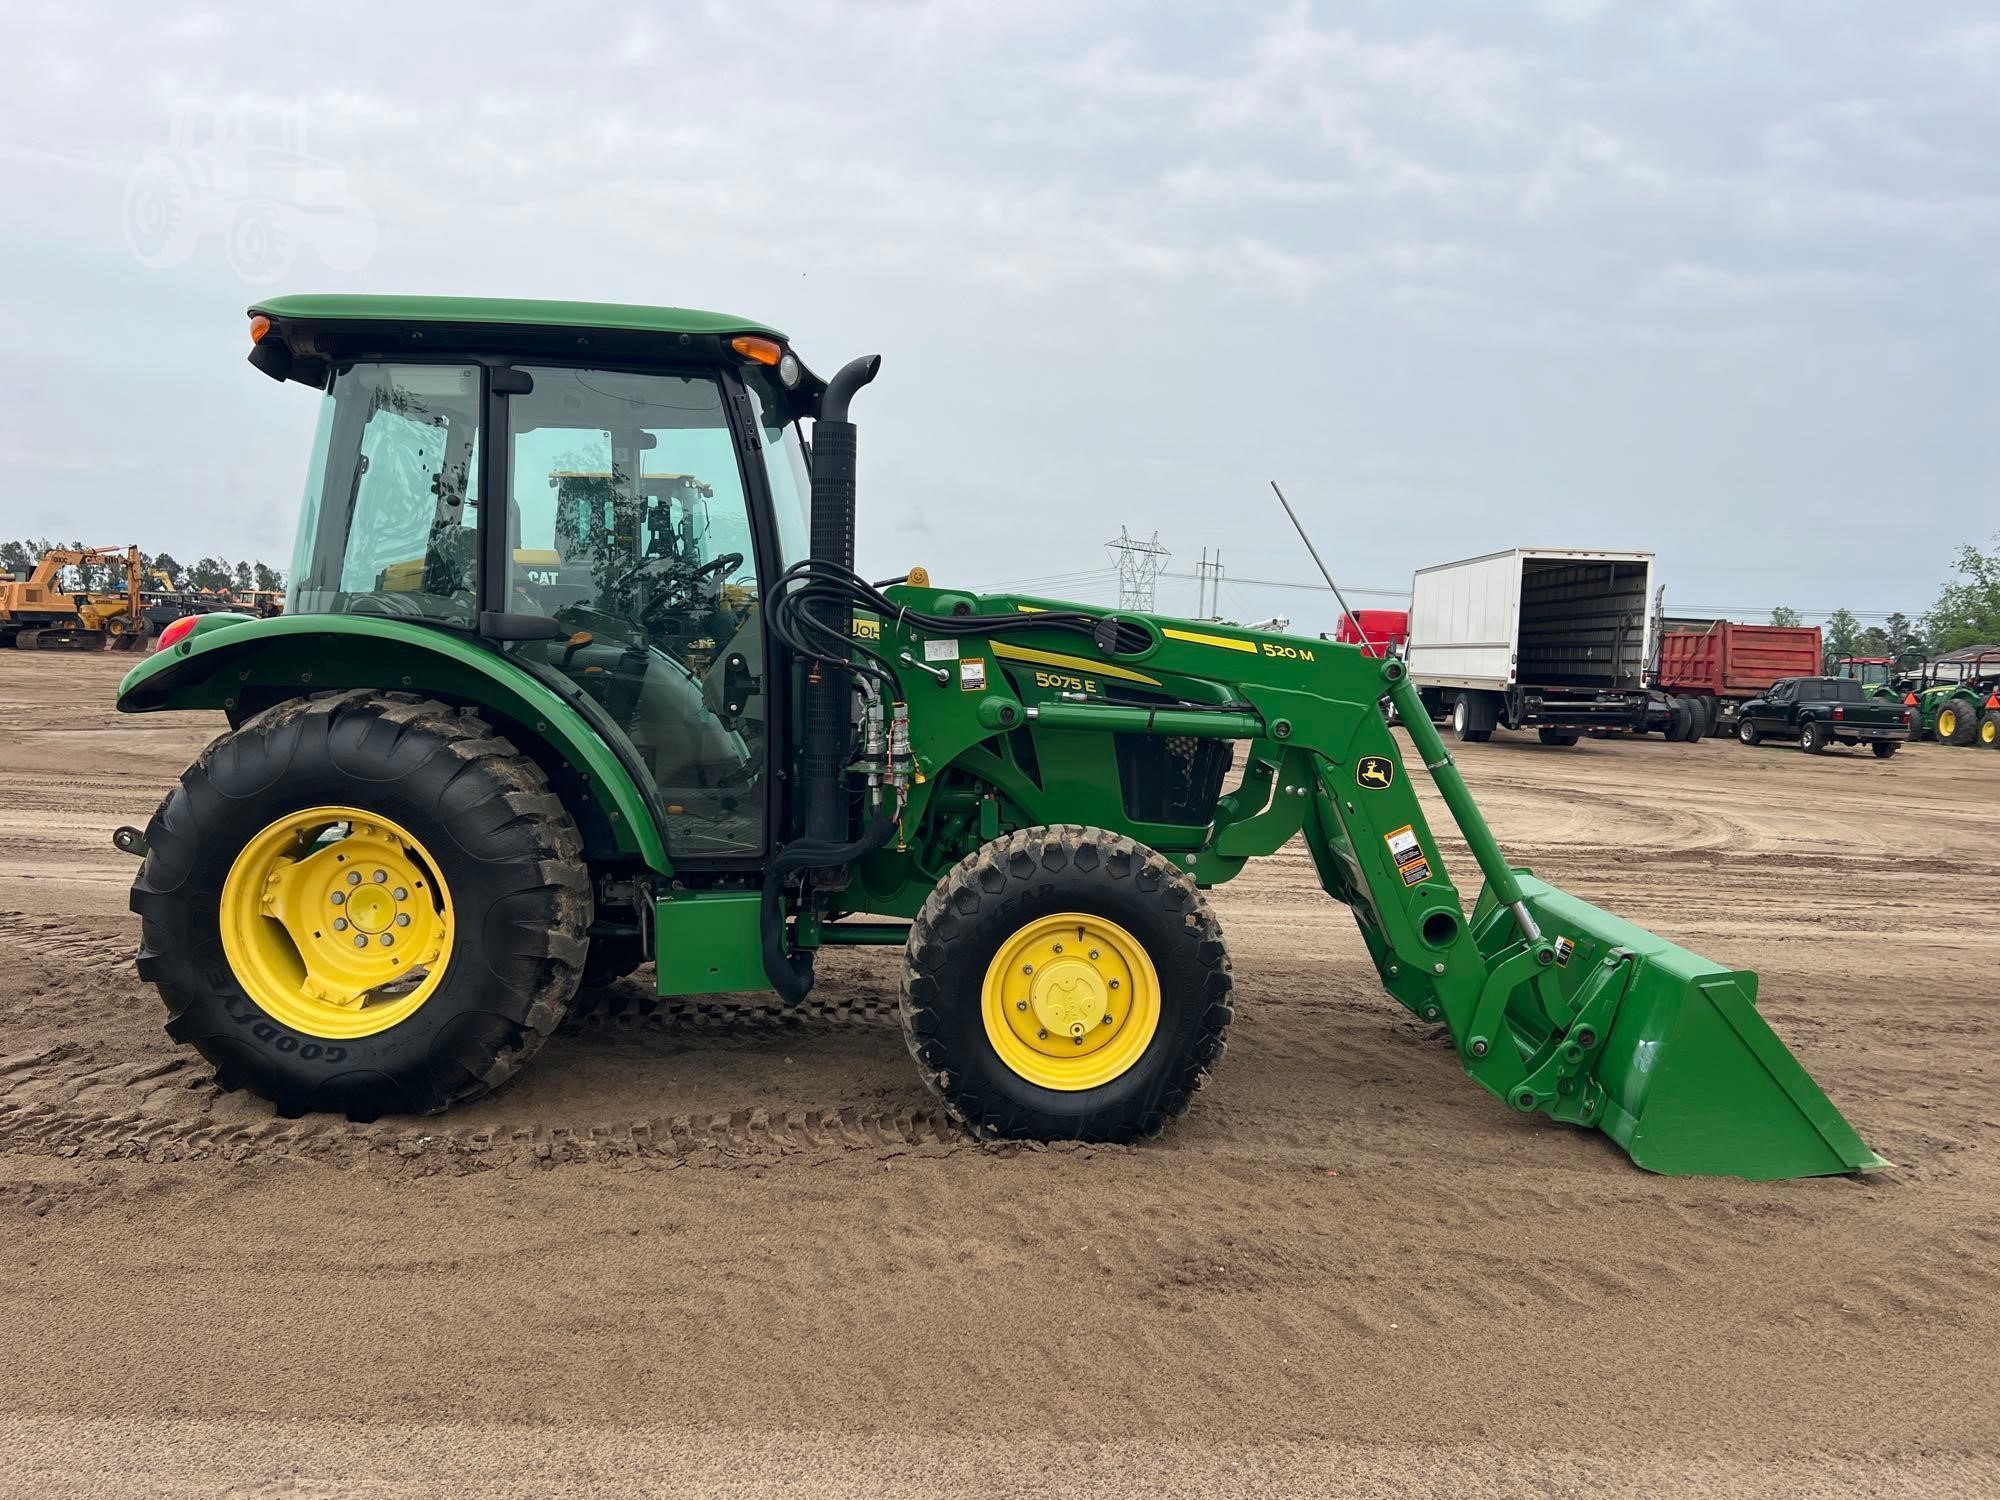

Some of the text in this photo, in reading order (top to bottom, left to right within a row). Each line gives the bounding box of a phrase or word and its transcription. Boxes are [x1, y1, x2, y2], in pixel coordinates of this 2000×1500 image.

[528, 571, 559, 586] CAT
[1262, 643, 1297, 659] 520
[1035, 672, 1082, 690] 5075
